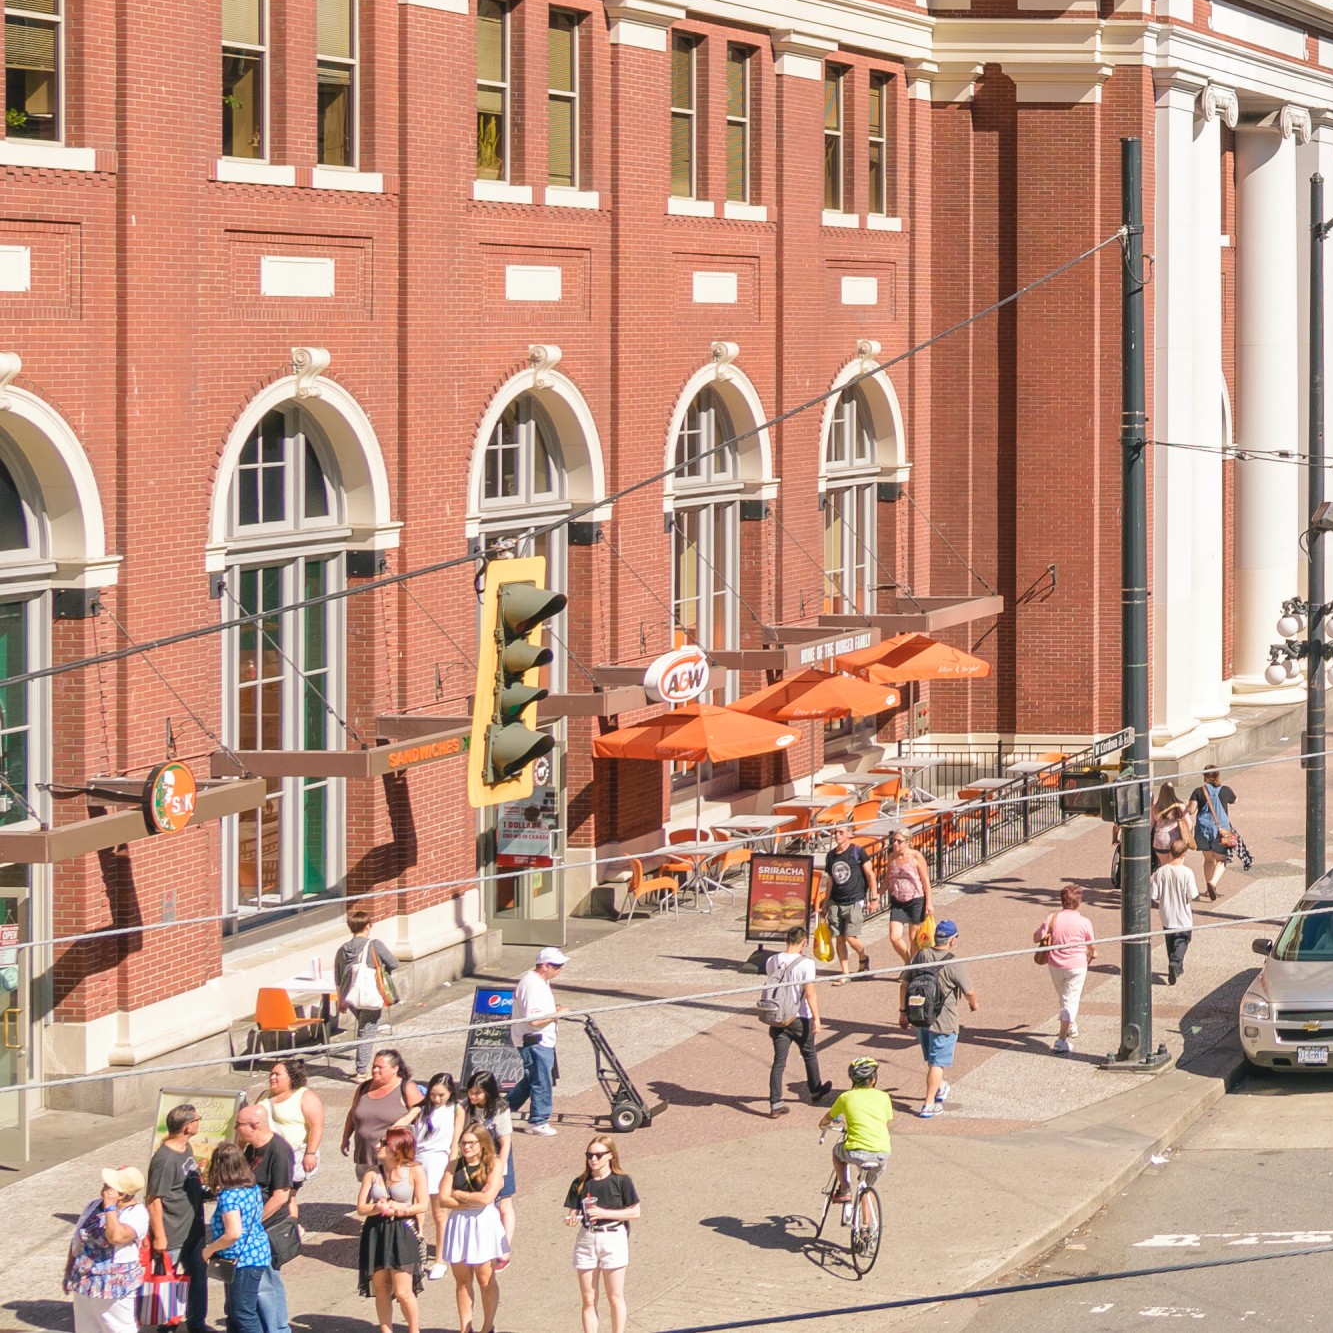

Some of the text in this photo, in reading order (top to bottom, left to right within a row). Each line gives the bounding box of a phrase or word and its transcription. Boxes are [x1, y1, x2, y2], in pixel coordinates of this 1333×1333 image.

[667, 666, 705, 694] A&W
[388, 737, 460, 768] SANDWICHES
[758, 866, 804, 876] SRIRACHA
